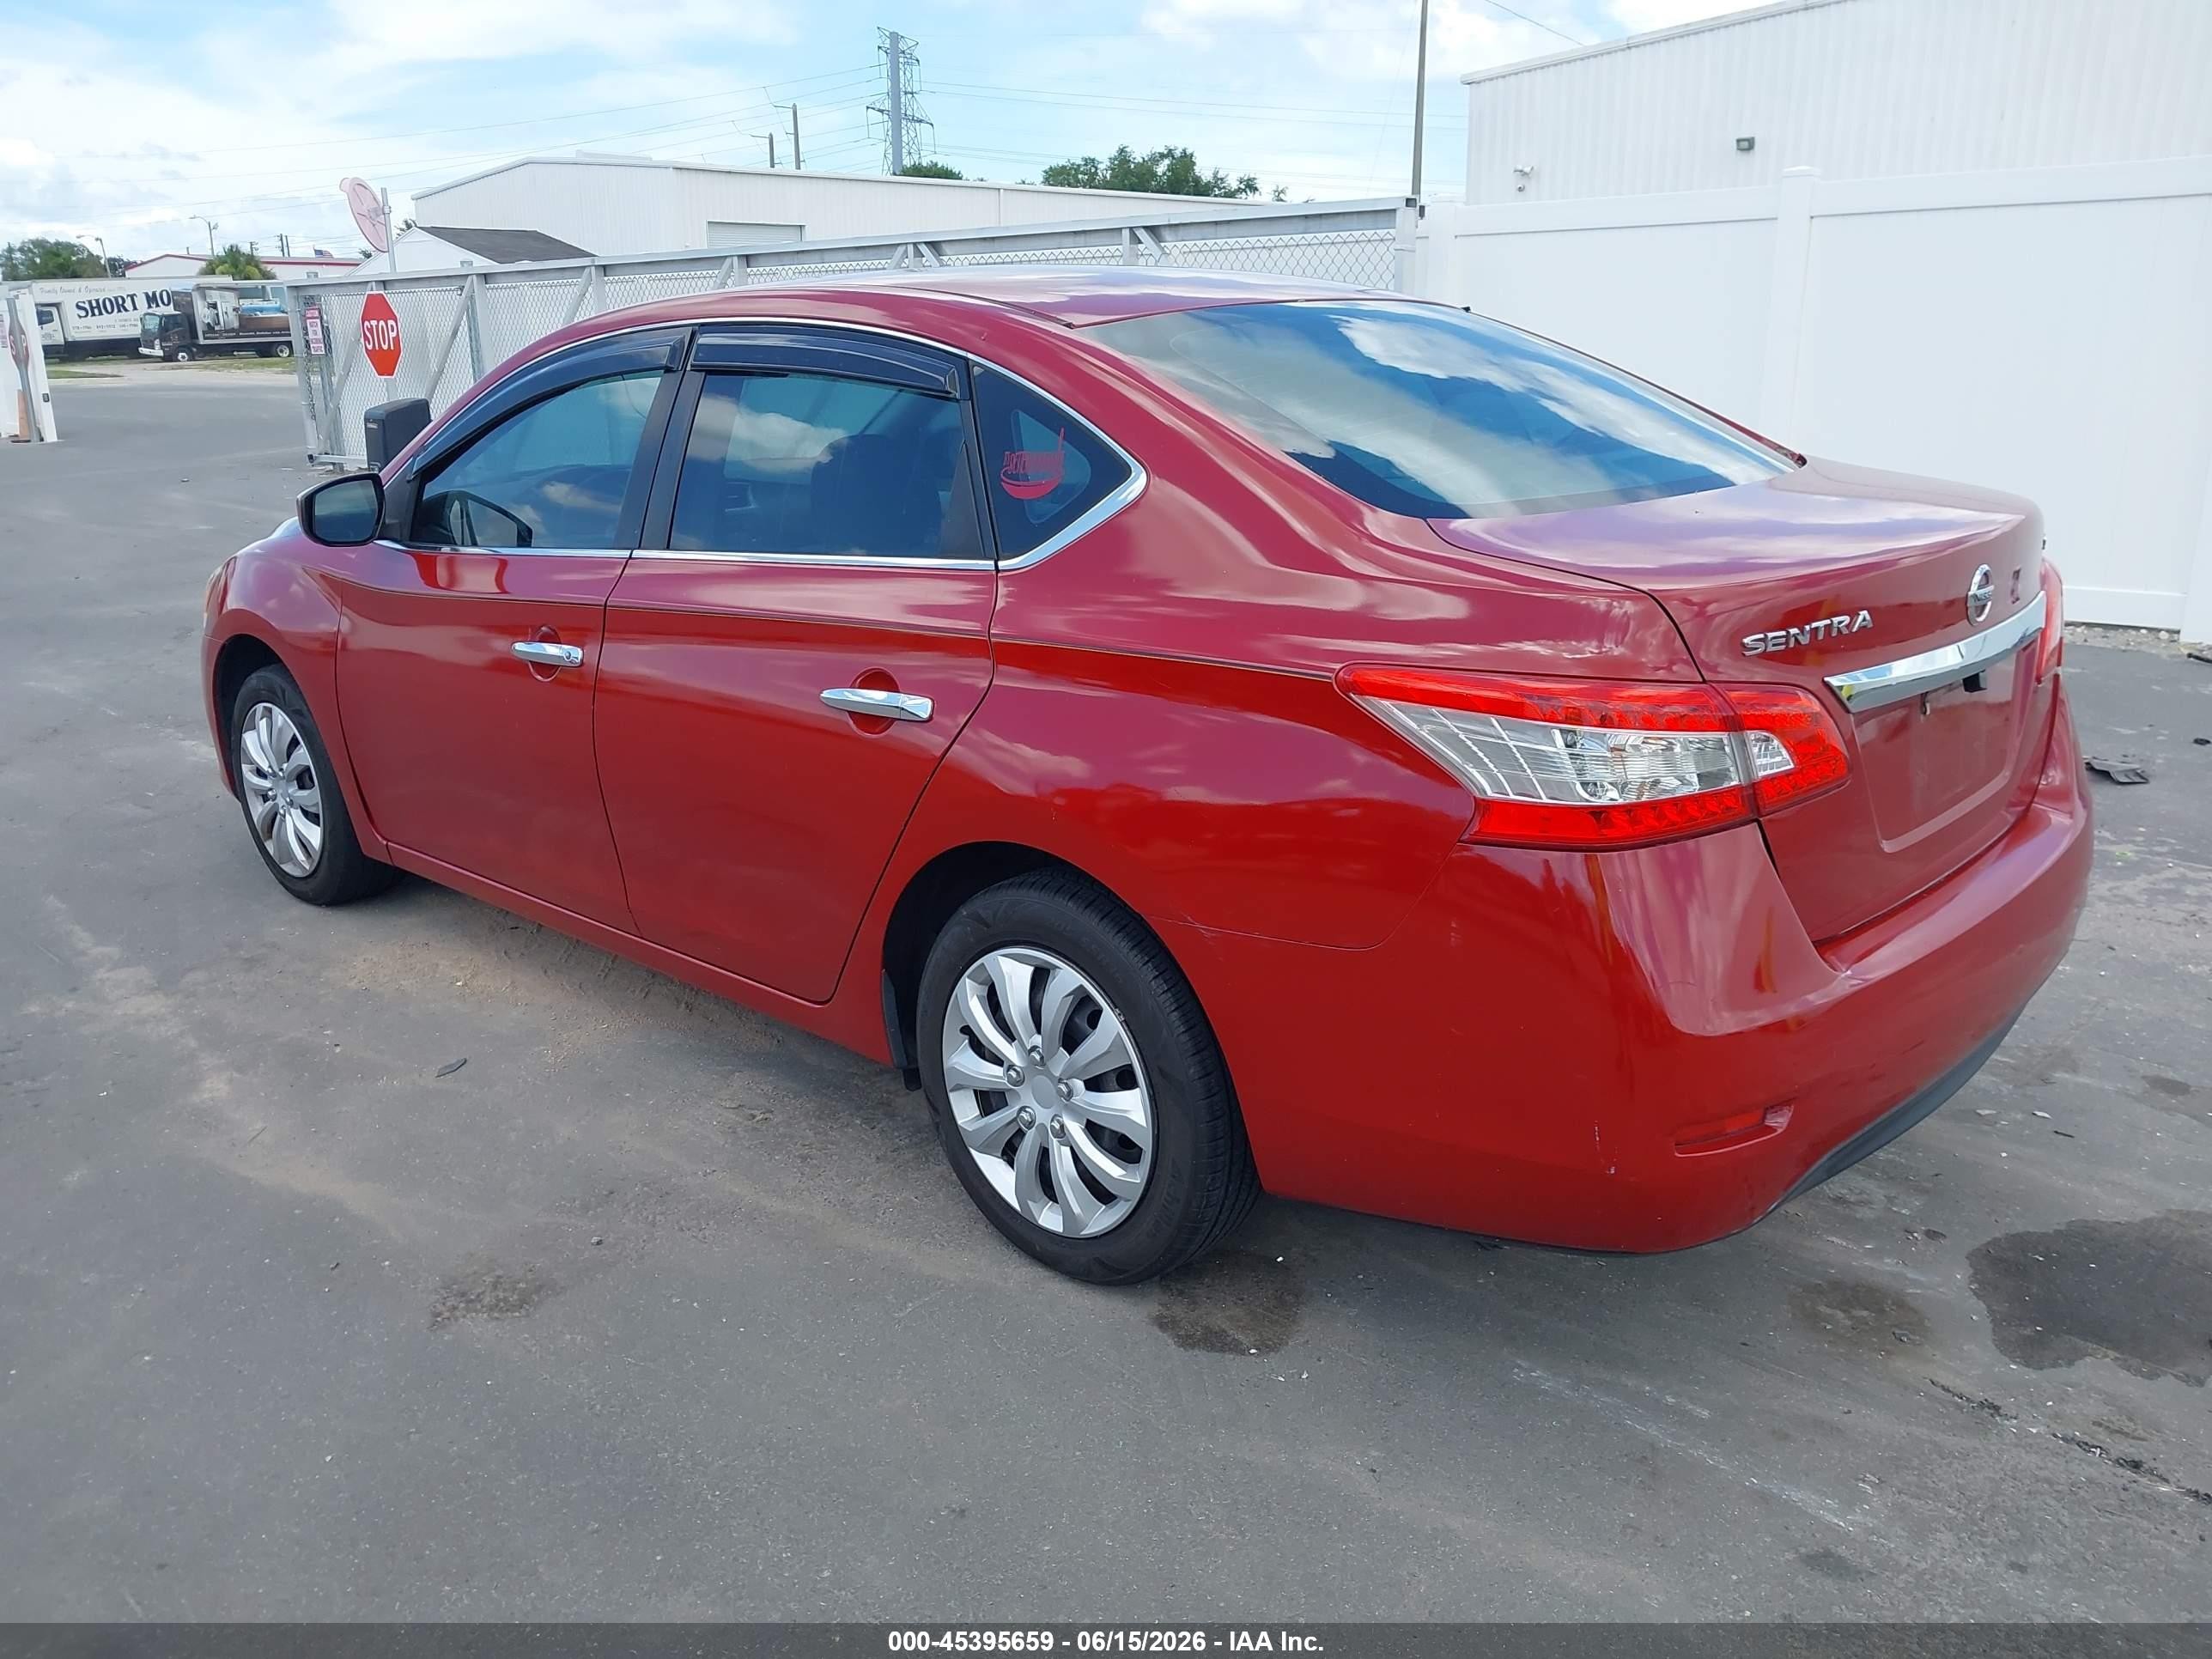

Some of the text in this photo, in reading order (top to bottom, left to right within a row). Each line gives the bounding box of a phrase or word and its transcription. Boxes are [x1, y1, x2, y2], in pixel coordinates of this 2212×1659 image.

[76, 289, 172, 319] SHORT MO
[9, 334, 27, 357] SP
[364, 319, 397, 350] STOP
[1741, 610, 1874, 656] SENTRA
